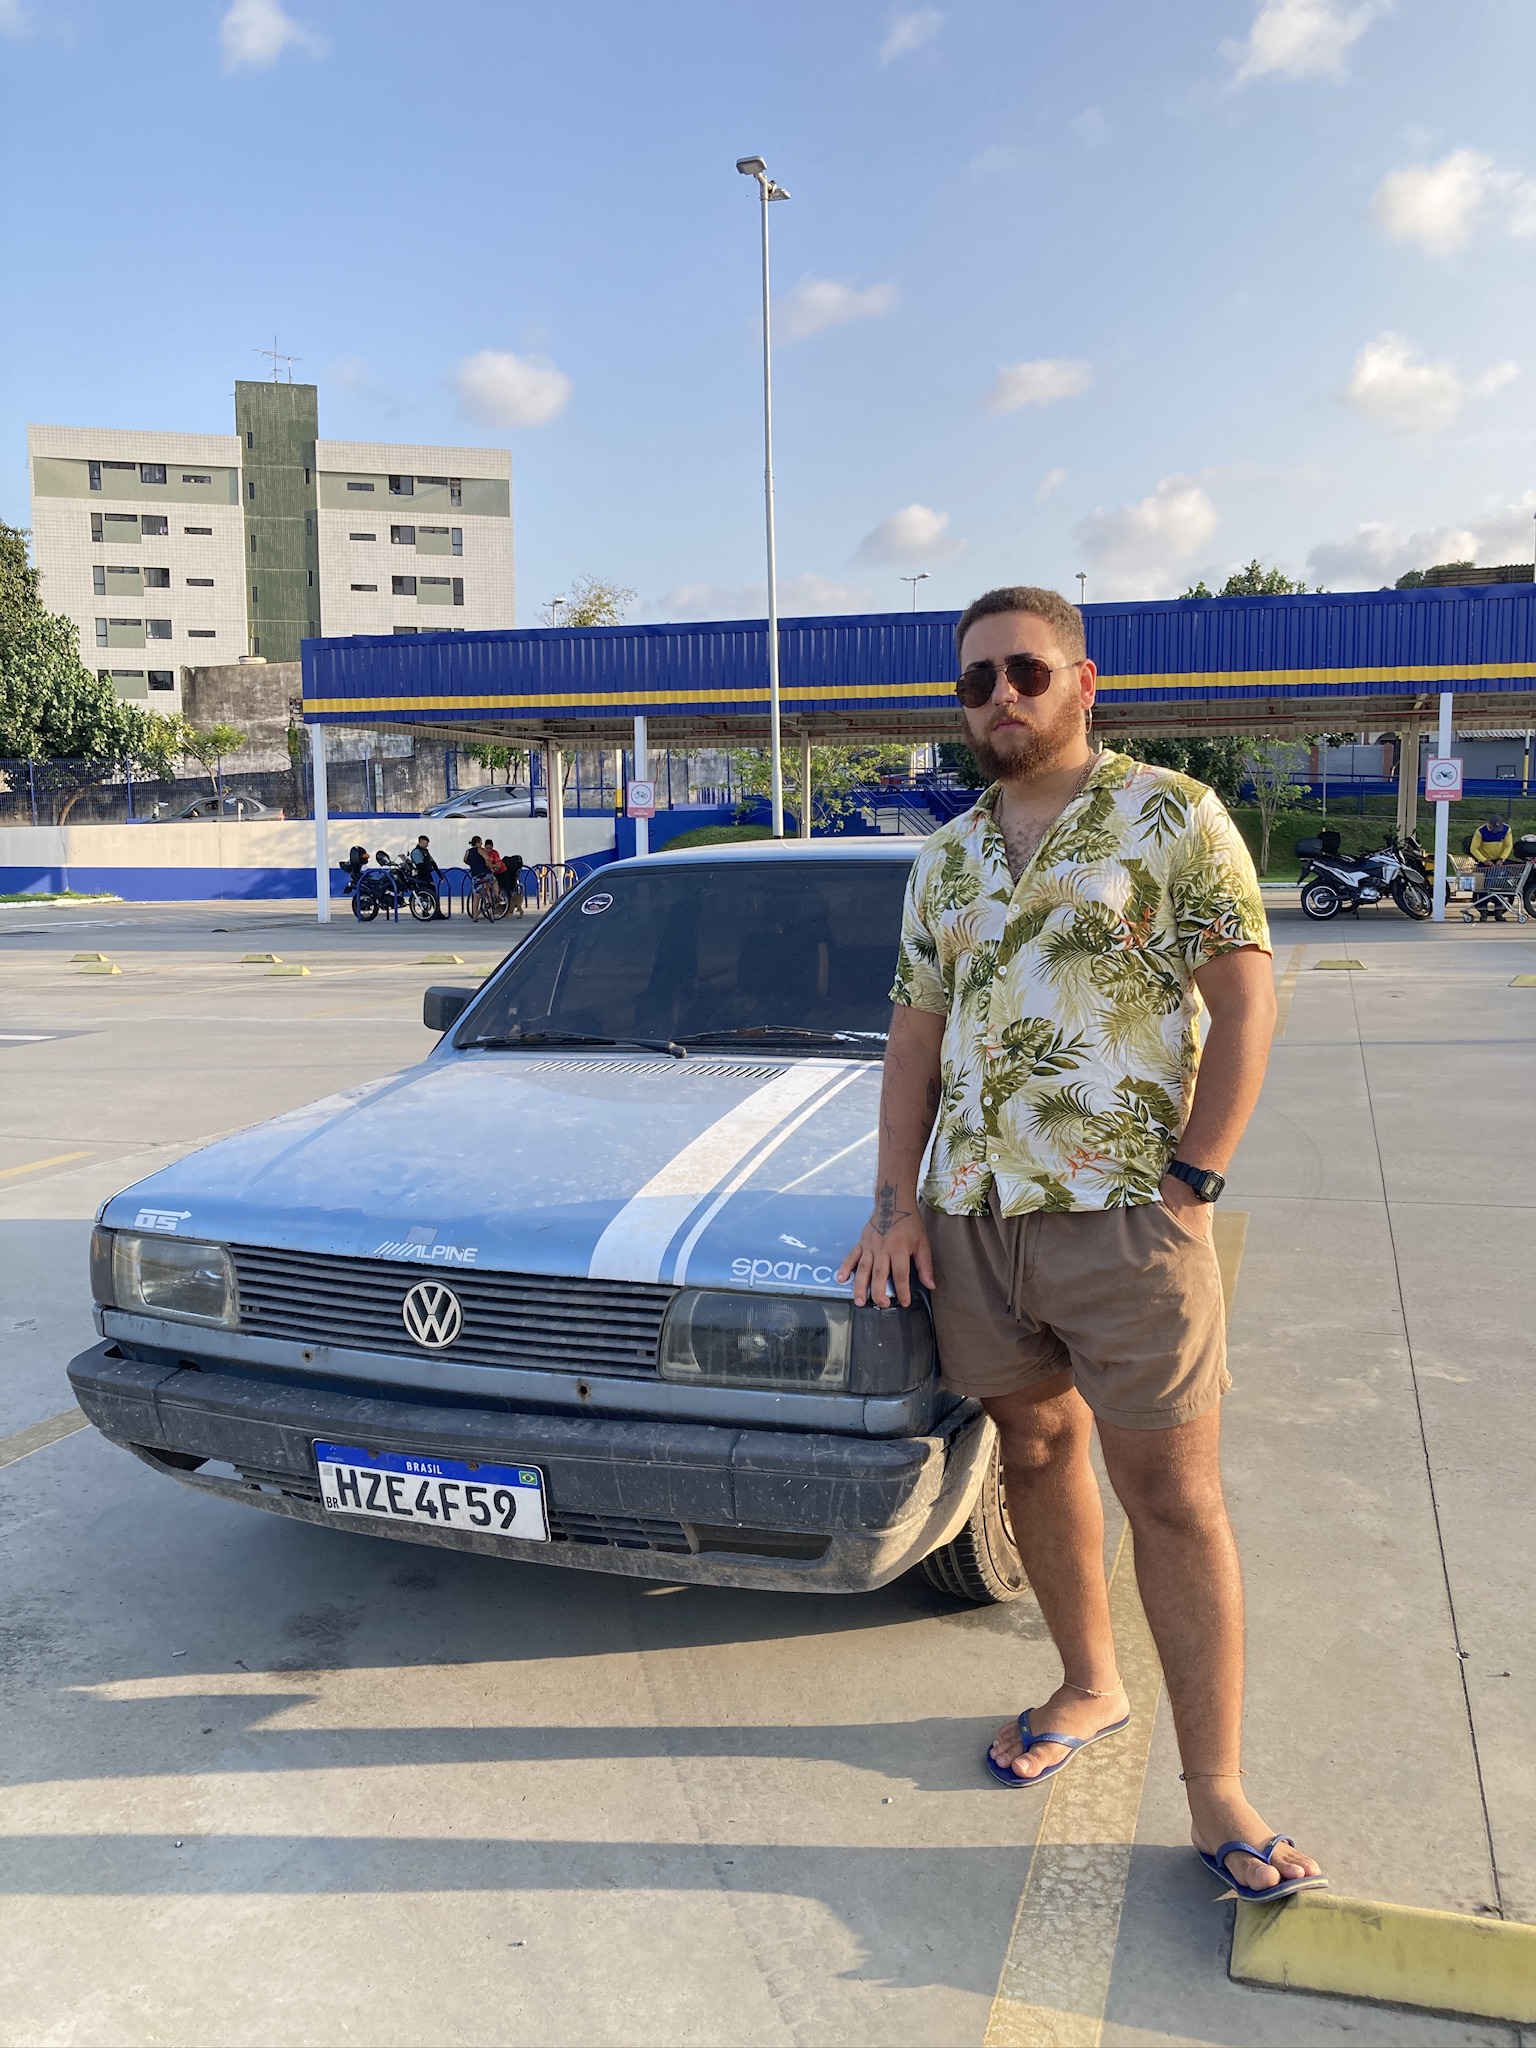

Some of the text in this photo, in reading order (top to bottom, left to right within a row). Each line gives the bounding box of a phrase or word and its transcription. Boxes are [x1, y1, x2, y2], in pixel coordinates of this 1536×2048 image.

[404, 1243, 478, 1263] ALPINE
[731, 1257, 855, 1288] sparco
[404, 1283, 461, 1347] VW
[406, 1461, 443, 1475] BRASIL
[326, 1496, 339, 1509] BR
[335, 1467, 517, 1530] HZE4F59
